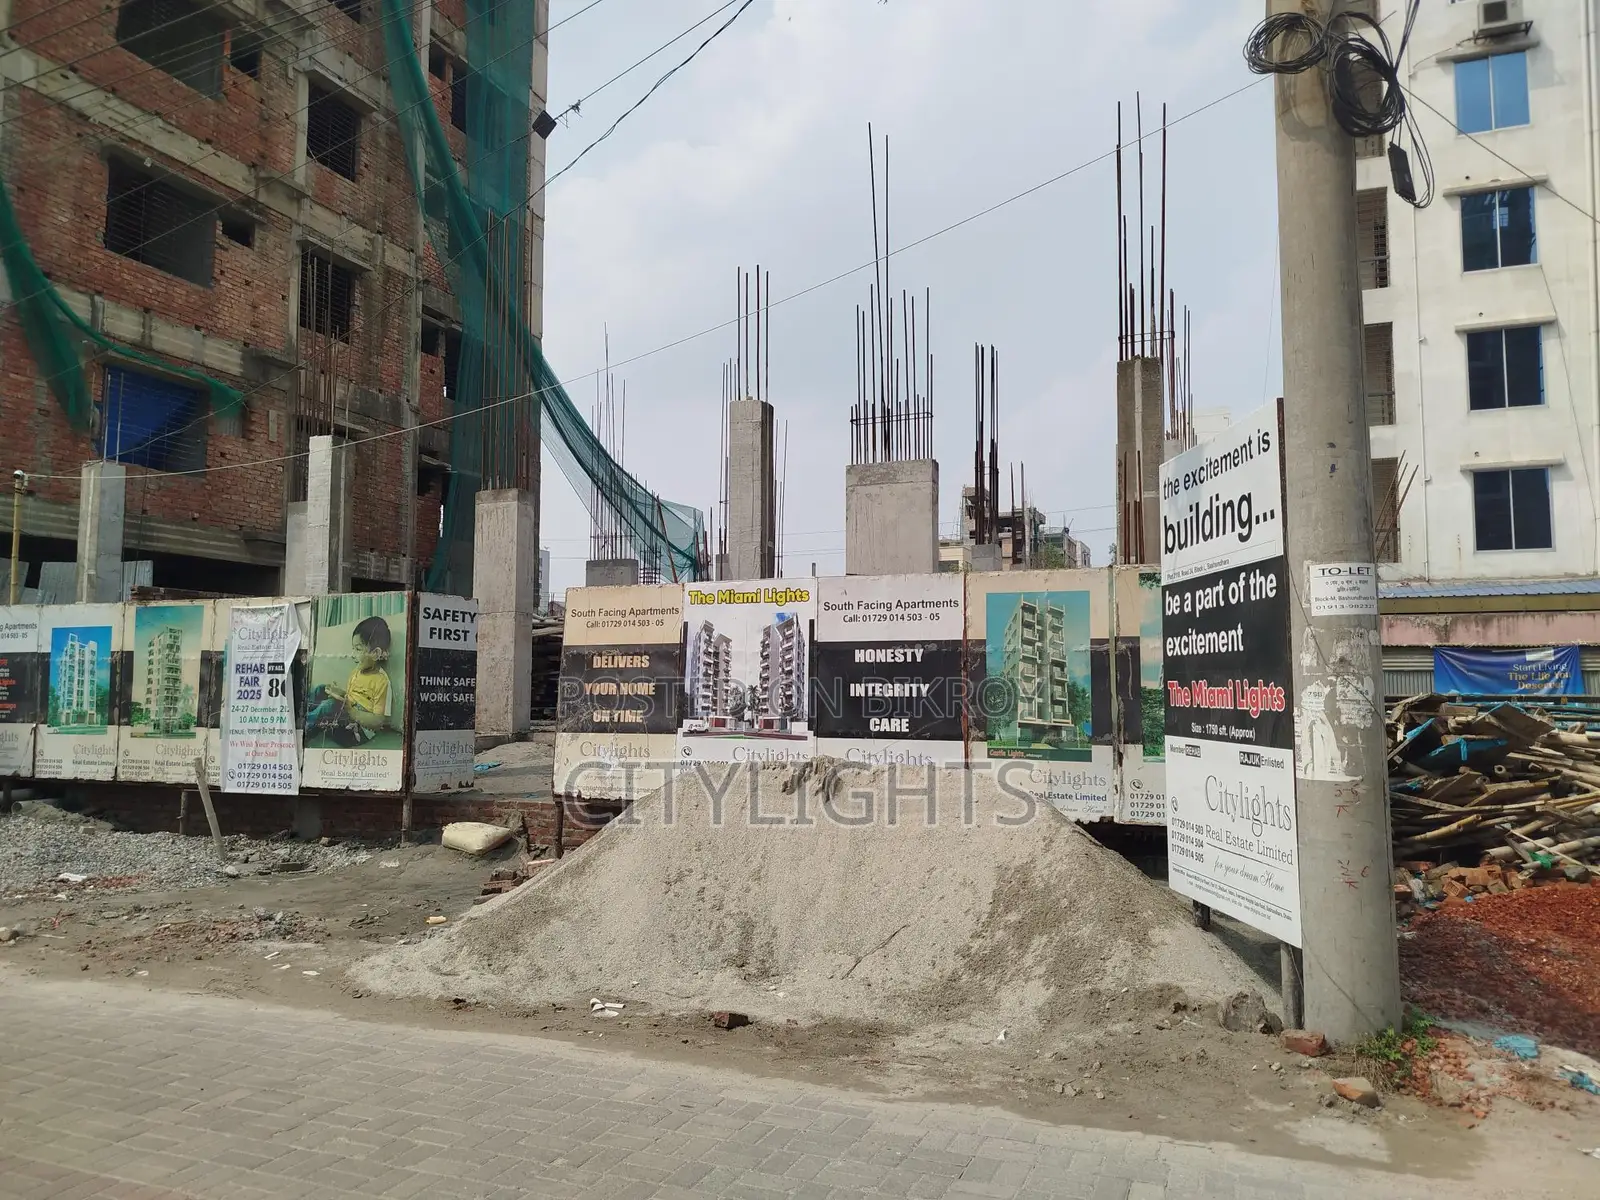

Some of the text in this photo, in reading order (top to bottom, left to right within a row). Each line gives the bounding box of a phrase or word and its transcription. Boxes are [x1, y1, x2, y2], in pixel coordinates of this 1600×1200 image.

[1163, 428, 1271, 501] the excitement is
[1164, 492, 1276, 555] building...
[1318, 566, 1371, 576] TO-LET
[688, 587, 811, 607] The Miami Lights
[1165, 568, 1277, 618] be a part of the
[823, 598, 960, 612] South Facing Apartments
[422, 606, 477, 624] SAFETY
[570, 606, 680, 619] South Facing Apartments
[842, 614, 860, 623] Call:
[862, 613, 888, 622] 01729
[889, 613, 905, 622] 014
[907, 613, 923, 621] 503
[929, 612, 941, 621] 05
[586, 620, 601, 629] Call:
[601, 620, 622, 628] 01729
[623, 619, 636, 627] 014
[638, 619, 650, 627] 503
[655, 619, 665, 627] 05
[429, 626, 470, 642] FIRST
[1166, 622, 1244, 657] excitement
[592, 655, 650, 669] DELIVERS
[854, 648, 924, 663] HONESTY
[235, 662, 265, 674] REHAB
[1513, 663, 1536, 672] Start
[239, 676, 260, 687] FAIR
[420, 676, 476, 687] THINK SAFE
[1508, 671, 1528, 681] The
[236, 689, 262, 700] 2025
[584, 682, 656, 696] YOUR HOME
[849, 683, 930, 698] INTEGRITY
[420, 692, 475, 703] WORK SAFE
[1167, 678, 1286, 719] The Miami Lights
[231, 705, 249, 713] 24-27
[592, 709, 644, 723] ON TIME
[239, 716, 248, 724] 10
[248, 716, 260, 724] AM
[261, 716, 269, 724] to
[269, 716, 275, 724] 9
[869, 717, 910, 732] CARE
[1191, 722, 1202, 734] Size
[1205, 723, 1219, 735] 1750
[1229, 726, 1256, 741] (Approx)
[155, 743, 202, 759] Citylights
[255, 740, 269, 748] Your
[419, 740, 474, 760] Citylights
[579, 740, 651, 761] Citylights
[322, 749, 388, 771] Citylights
[1239, 752, 1285, 769] RAJUK Enlisted
[237, 771, 261, 779] 01729
[337, 770, 359, 778] Estate
[1031, 768, 1107, 790] Citylights
[277, 782, 292, 790] 505
[1048, 791, 1073, 800] Estate
[1075, 793, 1107, 801] Limited
[1129, 792, 1155, 800] 01729
[1129, 801, 1155, 809] 01729
[1205, 774, 1292, 838] Citylights
[1130, 810, 1155, 818] 01729
[1171, 817, 1204, 835] 01729 014 503
[1171, 830, 1204, 849] 01729 014 504
[1205, 824, 1293, 865] Real Estate Limited
[1171, 843, 1204, 863] 01729 014 505
[1213, 855, 1285, 893] for your dream Home
